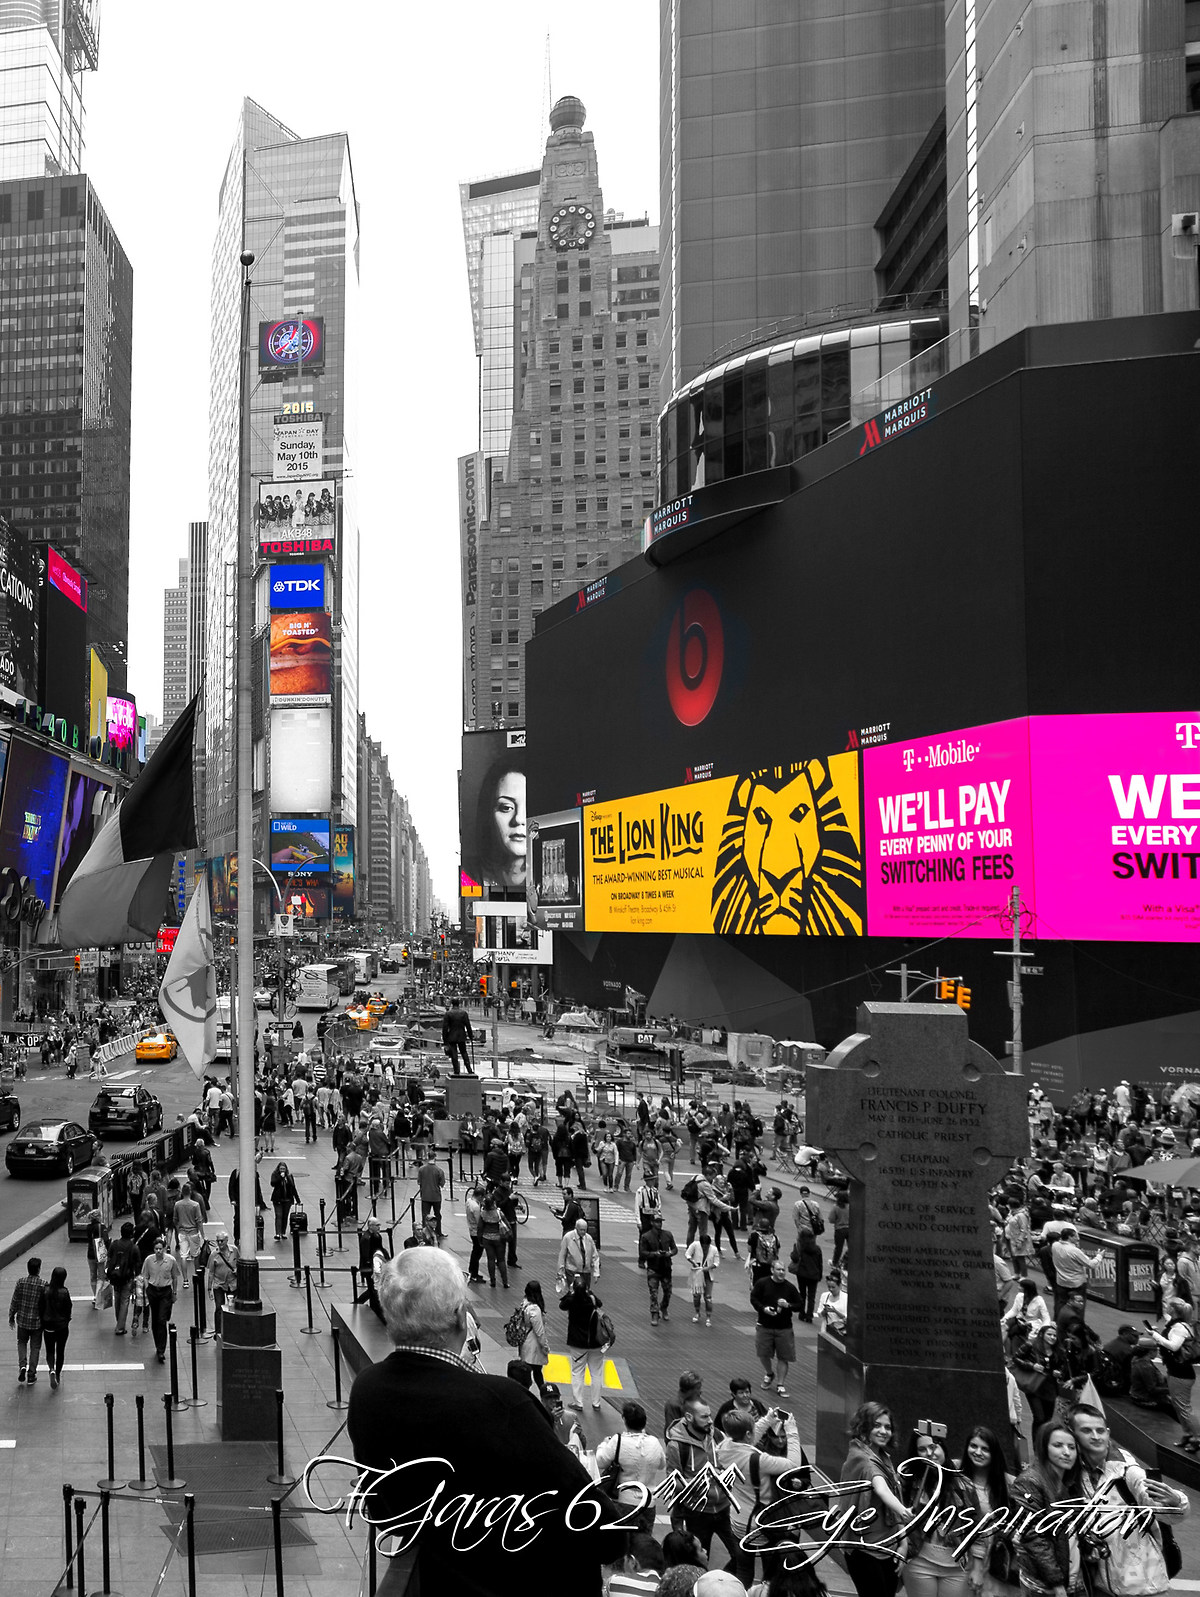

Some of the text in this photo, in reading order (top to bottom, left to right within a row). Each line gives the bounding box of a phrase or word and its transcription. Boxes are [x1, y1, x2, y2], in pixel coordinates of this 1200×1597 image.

[282, 401, 314, 414] 2015
[884, 388, 932, 423] MARRIOTT
[275, 413, 323, 424] TOSHIBA
[884, 406, 928, 438] MARQUIS
[279, 441, 316, 451] Sunday,
[277, 451, 319, 462] May 10th
[286, 461, 309, 471] 2015
[653, 495, 694, 523] MARRIOTT
[653, 511, 689, 536] MARQUIS
[280, 527, 313, 540] AKB48
[260, 539, 333, 553] TOSHIBA
[284, 579, 321, 592] TDK
[289, 621, 303, 630] BIG
[860, 722, 891, 737] MARRIOTT
[860, 733, 888, 747] MARQUIS
[878, 779, 1012, 835] WE’LL PAY
[590, 802, 704, 865] THE LION KING
[1112, 825, 1198, 846] EVERY
[880, 828, 1013, 857] EVERY PENNY OF YOUR
[593, 866, 704, 885] THE AWARD-WINNING BEST MUSICAL
[881, 853, 1015, 885] SWITCHING FEES
[611, 893, 617, 901] ON
[618, 891, 640, 900] BROADWAY
[645, 890, 657, 899] TIMES
[664, 889, 675, 898] WEEK
[637, 1033, 654, 1044] CAT
[867, 1086, 978, 1101] LIEUTENANT COLONEL
[860, 1099, 988, 1116] FRANCIS DUFFY
[868, 1113, 887, 1123] MAY
[877, 1129, 972, 1143] CATHOLIC PRIEST
[899, 1153, 950, 1165] CHAPLAIN
[928, 1167, 975, 1179] INFANTRY
[891, 1179, 913, 1188] OLD
[881, 1202, 977, 1217] A LIFE OF SERVICE
[919, 1214, 936, 1222] FOR
[877, 1220, 980, 1235] GOD AND COUNTRY
[1127, 1263, 1155, 1278] JERSEY
[1133, 1280, 1153, 1293] BOYS
